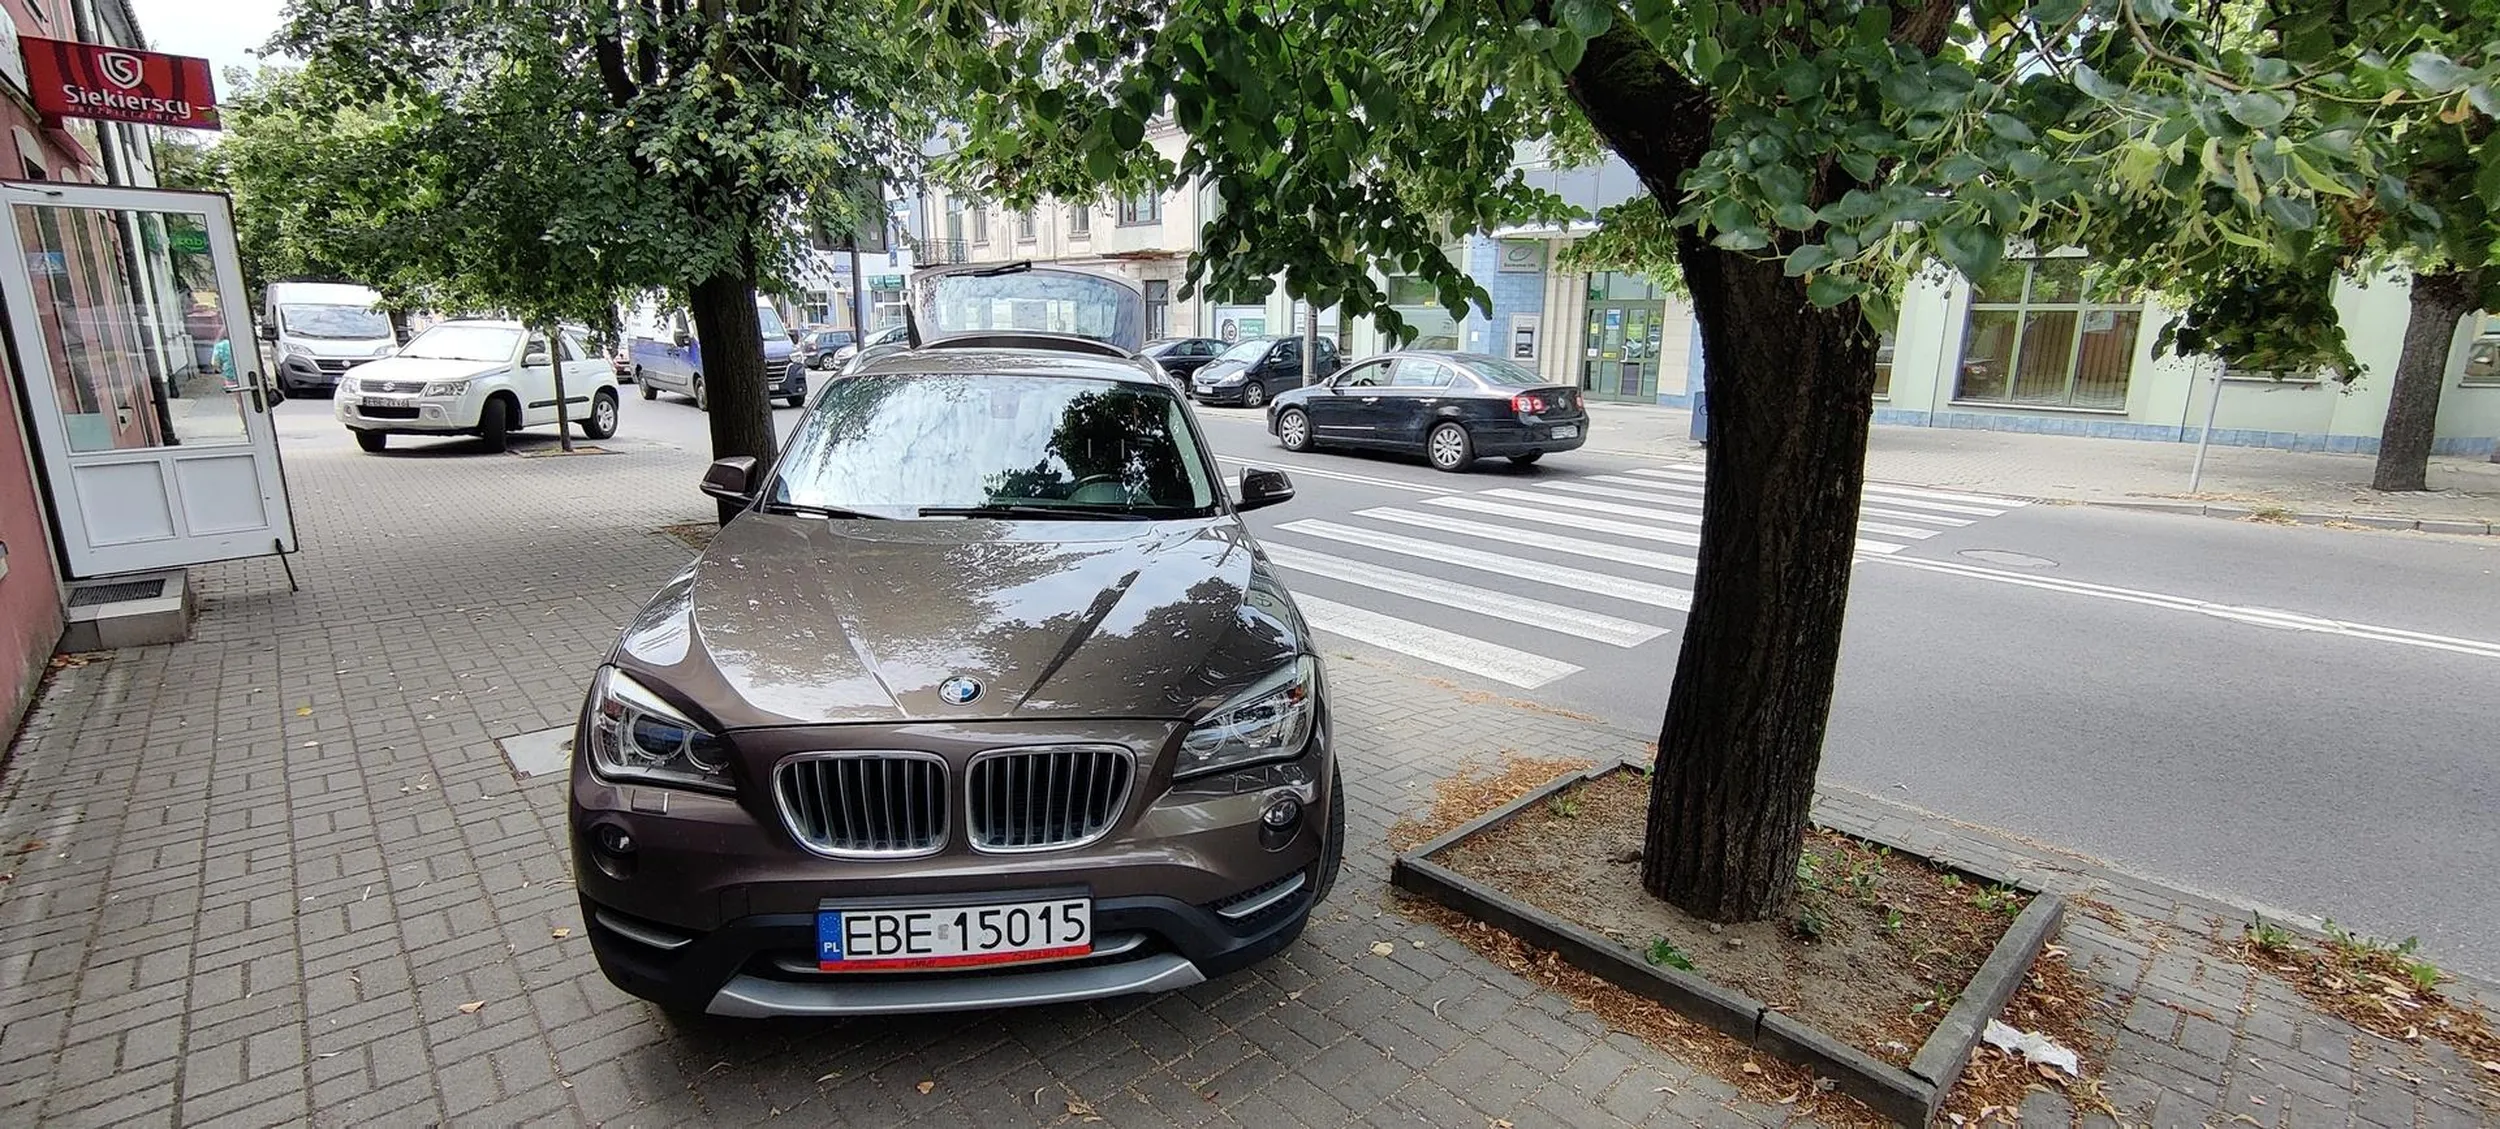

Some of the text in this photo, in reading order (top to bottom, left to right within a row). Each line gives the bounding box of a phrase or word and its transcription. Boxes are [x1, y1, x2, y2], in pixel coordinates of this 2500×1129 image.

[62, 84, 192, 119] Siekierscy
[845, 903, 1085, 956] EBE 15015
[823, 942, 841, 953] PL
